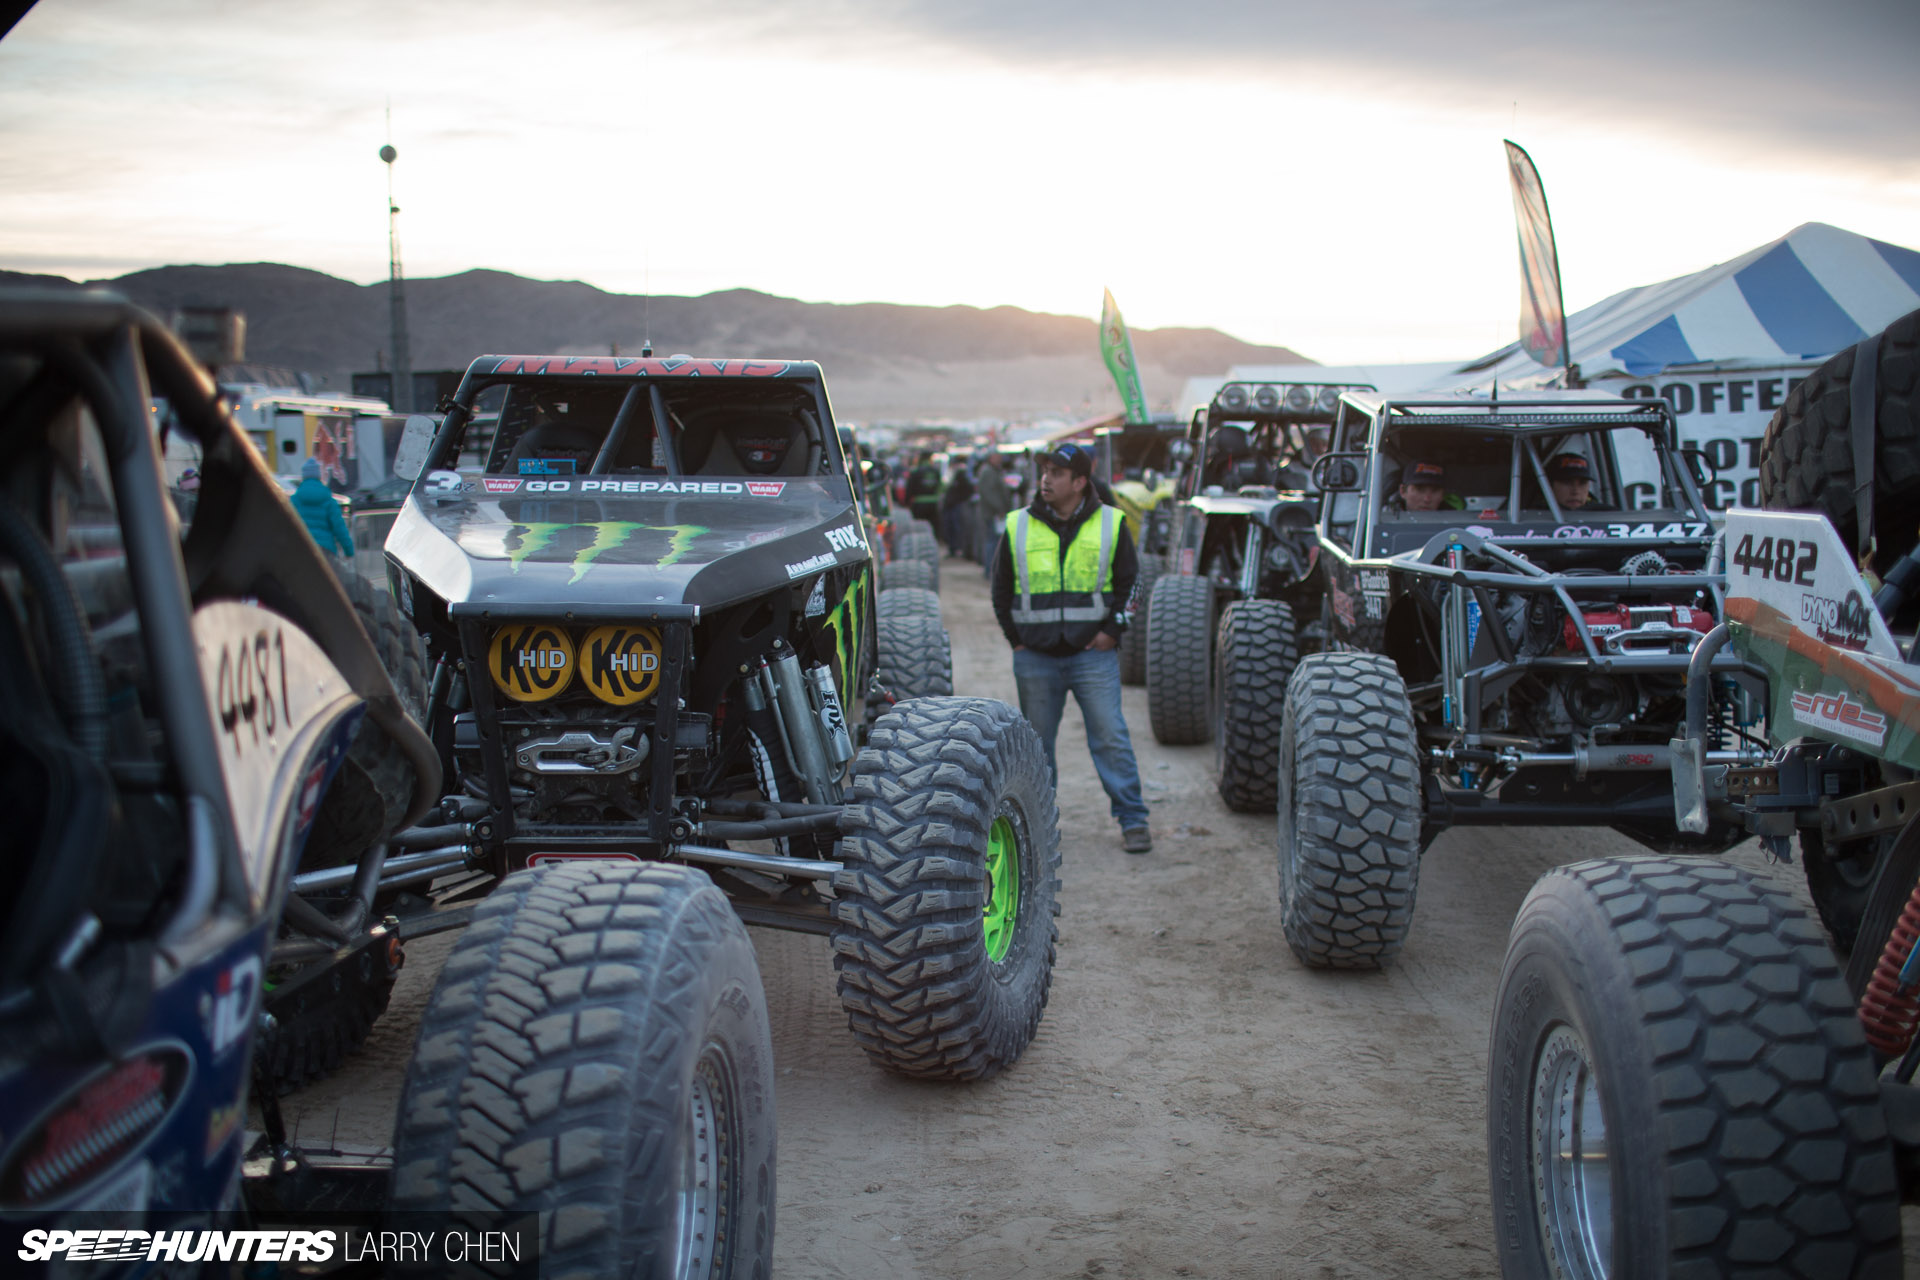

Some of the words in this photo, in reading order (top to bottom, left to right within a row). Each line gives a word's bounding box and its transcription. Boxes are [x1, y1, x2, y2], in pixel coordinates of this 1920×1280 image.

[526, 481, 570, 492] GO
[581, 481, 743, 494] PREPARED
[824, 524, 860, 552] FOX
[1607, 523, 1708, 539] 3447
[1733, 534, 1818, 587] 4482
[500, 625, 561, 693] KC
[518, 650, 566, 669] HID
[592, 629, 653, 697] KC
[610, 653, 659, 671] HID
[821, 691, 845, 736] FOX
